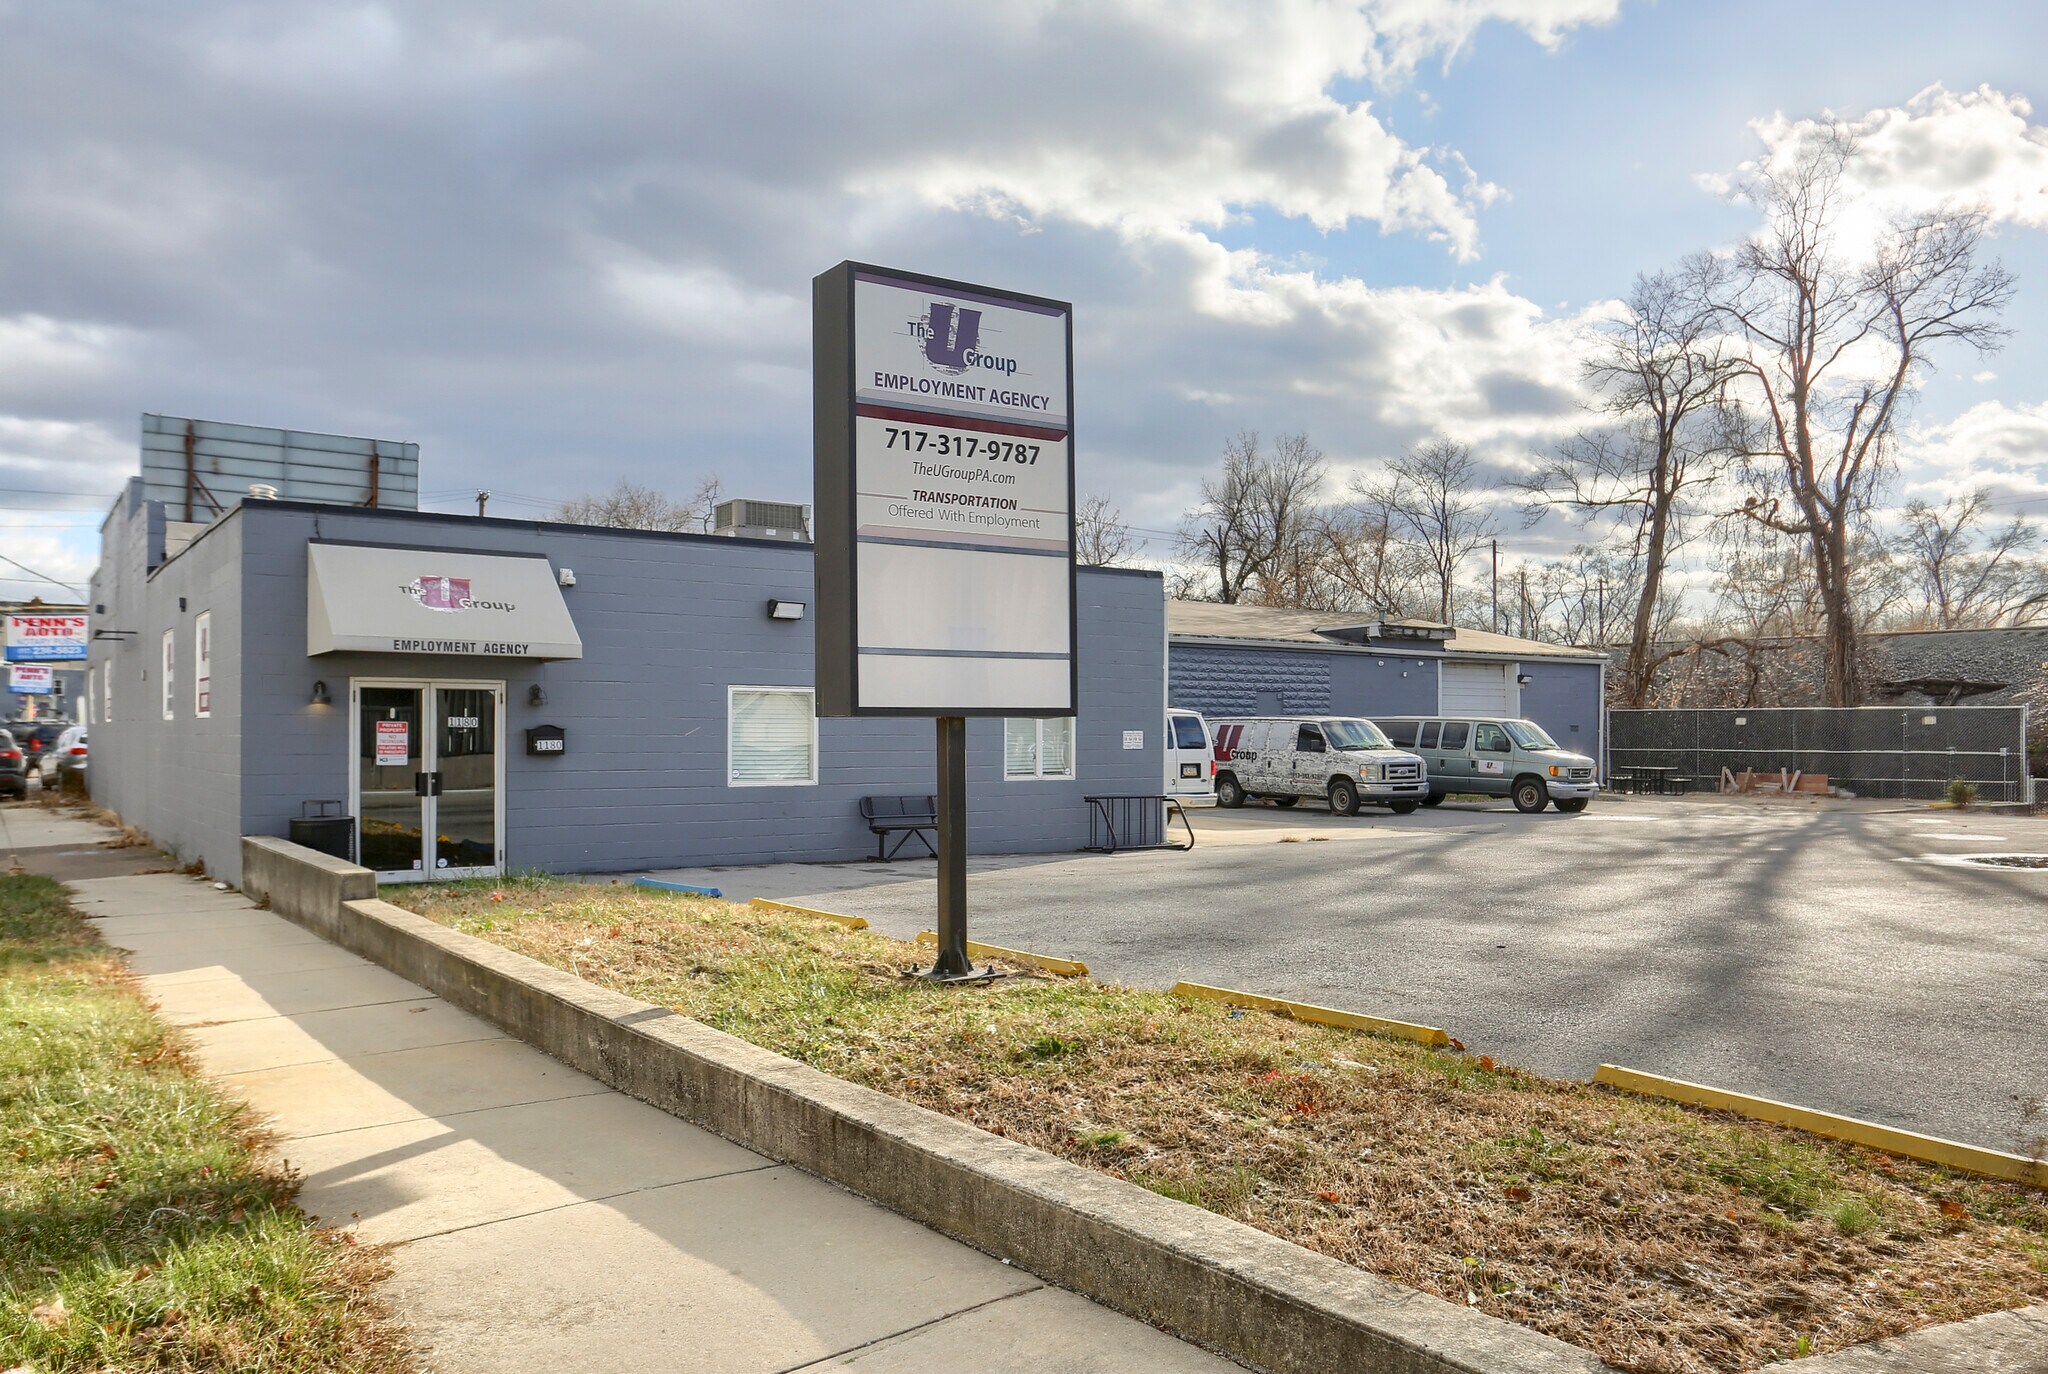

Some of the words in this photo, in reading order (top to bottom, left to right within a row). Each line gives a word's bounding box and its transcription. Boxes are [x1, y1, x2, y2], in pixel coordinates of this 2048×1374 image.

[906, 321, 935, 340] The
[924, 302, 983, 375] U
[962, 348, 1017, 376] Group
[874, 371, 986, 402] EMPLOYMENT
[989, 389, 1050, 410] AGENCY
[885, 427, 1041, 466] 717-317-9787
[912, 461, 1016, 485] TheUGroupPA.com
[912, 489, 1018, 511] TRANSPORTATION
[888, 503, 934, 520] Offered
[938, 508, 966, 523] With
[968, 511, 1040, 529] Employment
[398, 585, 427, 596] The
[458, 598, 516, 613] Group
[393, 639, 477, 654] EMPLOYMENT
[483, 643, 529, 655] AGENCY
[448, 717, 478, 727] 1180
[538, 740, 562, 750] 1180
